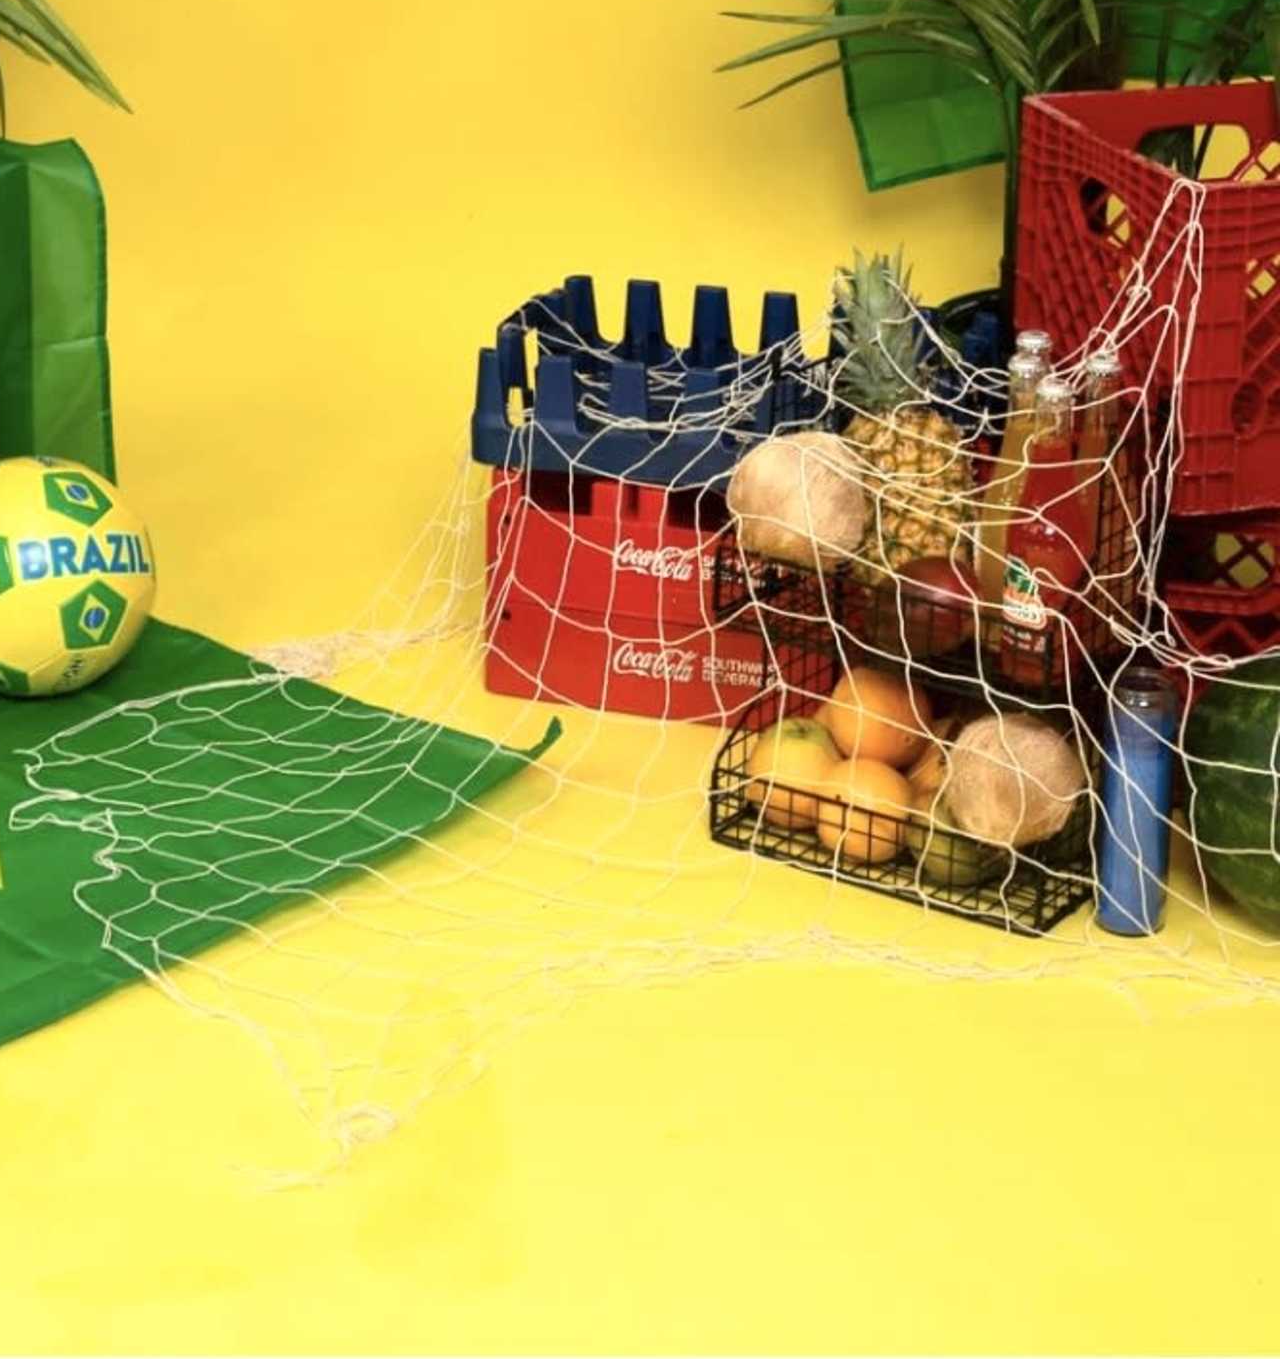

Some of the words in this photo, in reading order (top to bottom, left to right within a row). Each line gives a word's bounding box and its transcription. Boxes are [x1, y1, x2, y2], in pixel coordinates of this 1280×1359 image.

[17, 533, 150, 581] BRAZIL
[615, 539, 698, 581] Coca-Cola
[613, 642, 698, 683] Coca-Cola
